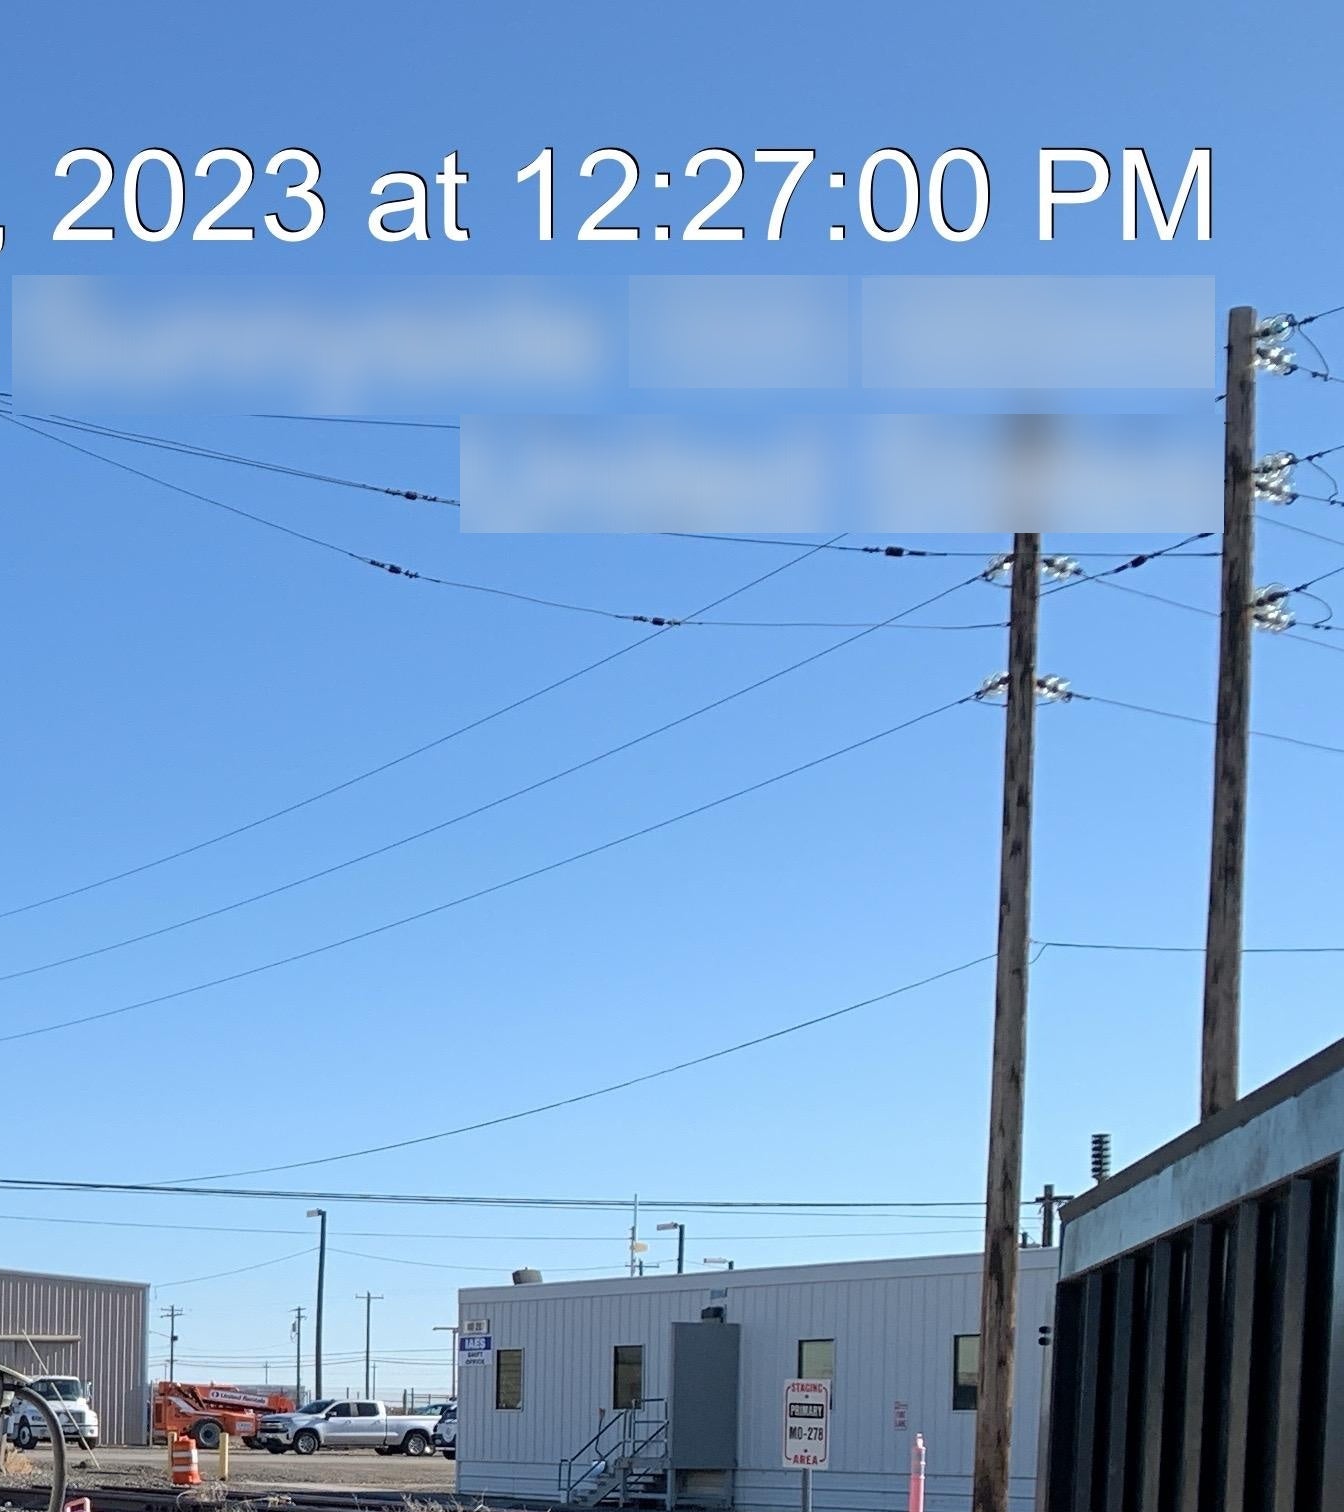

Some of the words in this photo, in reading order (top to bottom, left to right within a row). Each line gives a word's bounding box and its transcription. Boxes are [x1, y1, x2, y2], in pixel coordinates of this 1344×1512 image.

[791, 1383, 823, 1393] STAGING
[791, 1405, 823, 1417] PRIMARY
[789, 1426, 824, 1441] MO-278
[792, 1455, 818, 1465] AREA
